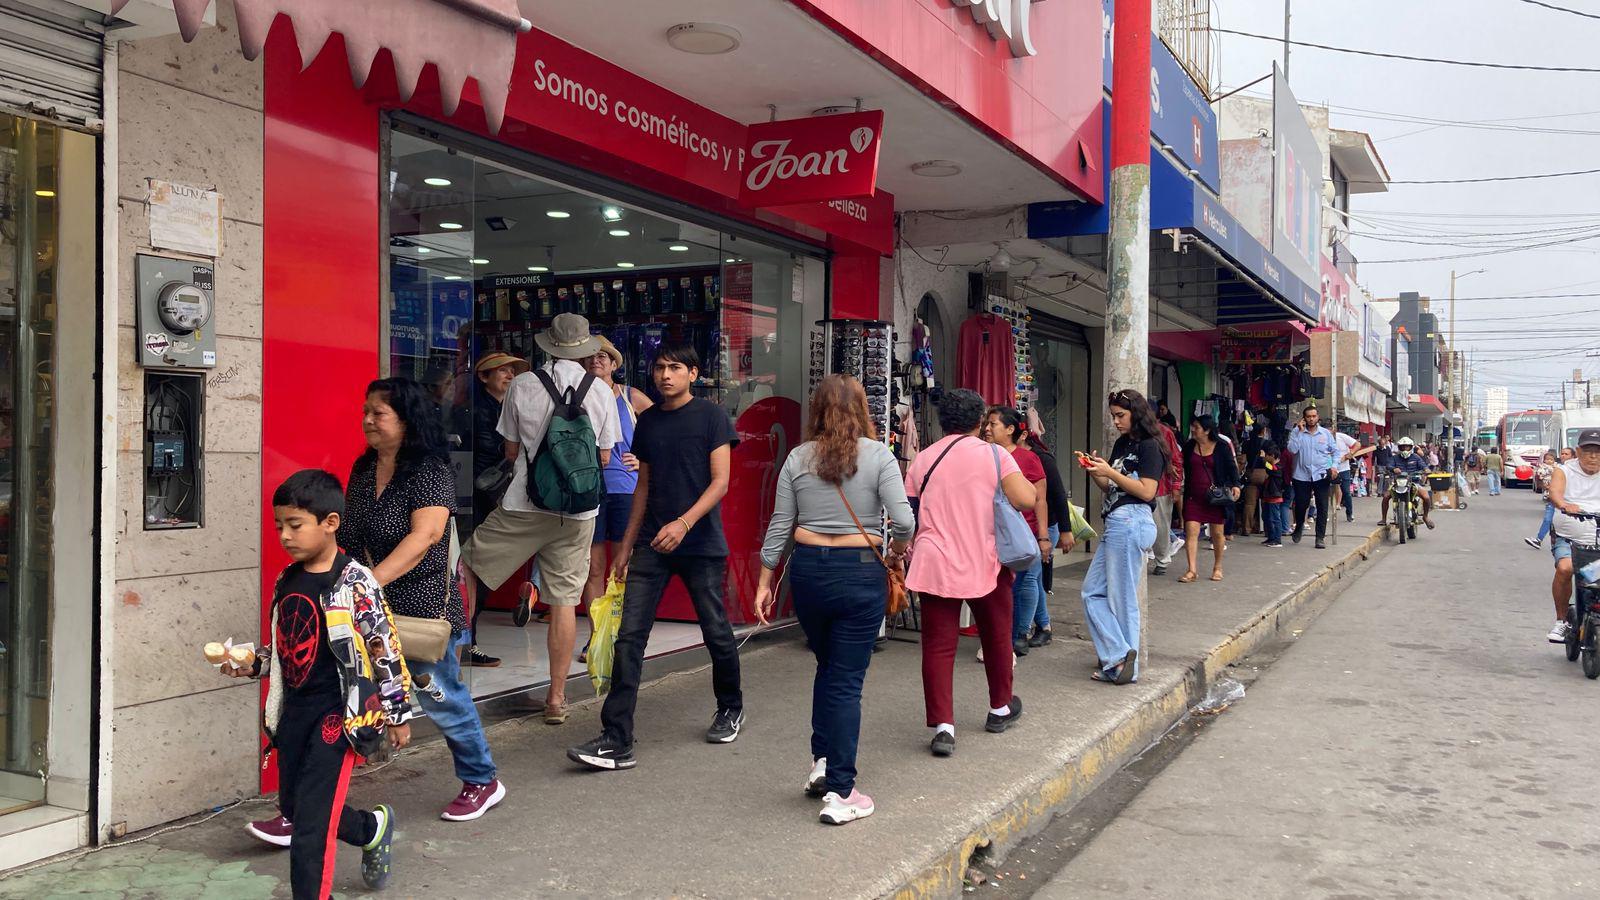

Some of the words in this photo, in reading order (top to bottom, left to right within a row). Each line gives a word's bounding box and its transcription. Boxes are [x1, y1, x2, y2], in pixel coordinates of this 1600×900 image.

[533, 59, 608, 115] Somos
[614, 100, 718, 161] cosméticos
[722, 146, 732, 171] y
[746, 139, 850, 191] Joan
[495, 275, 541, 286] EXTENSIONES
